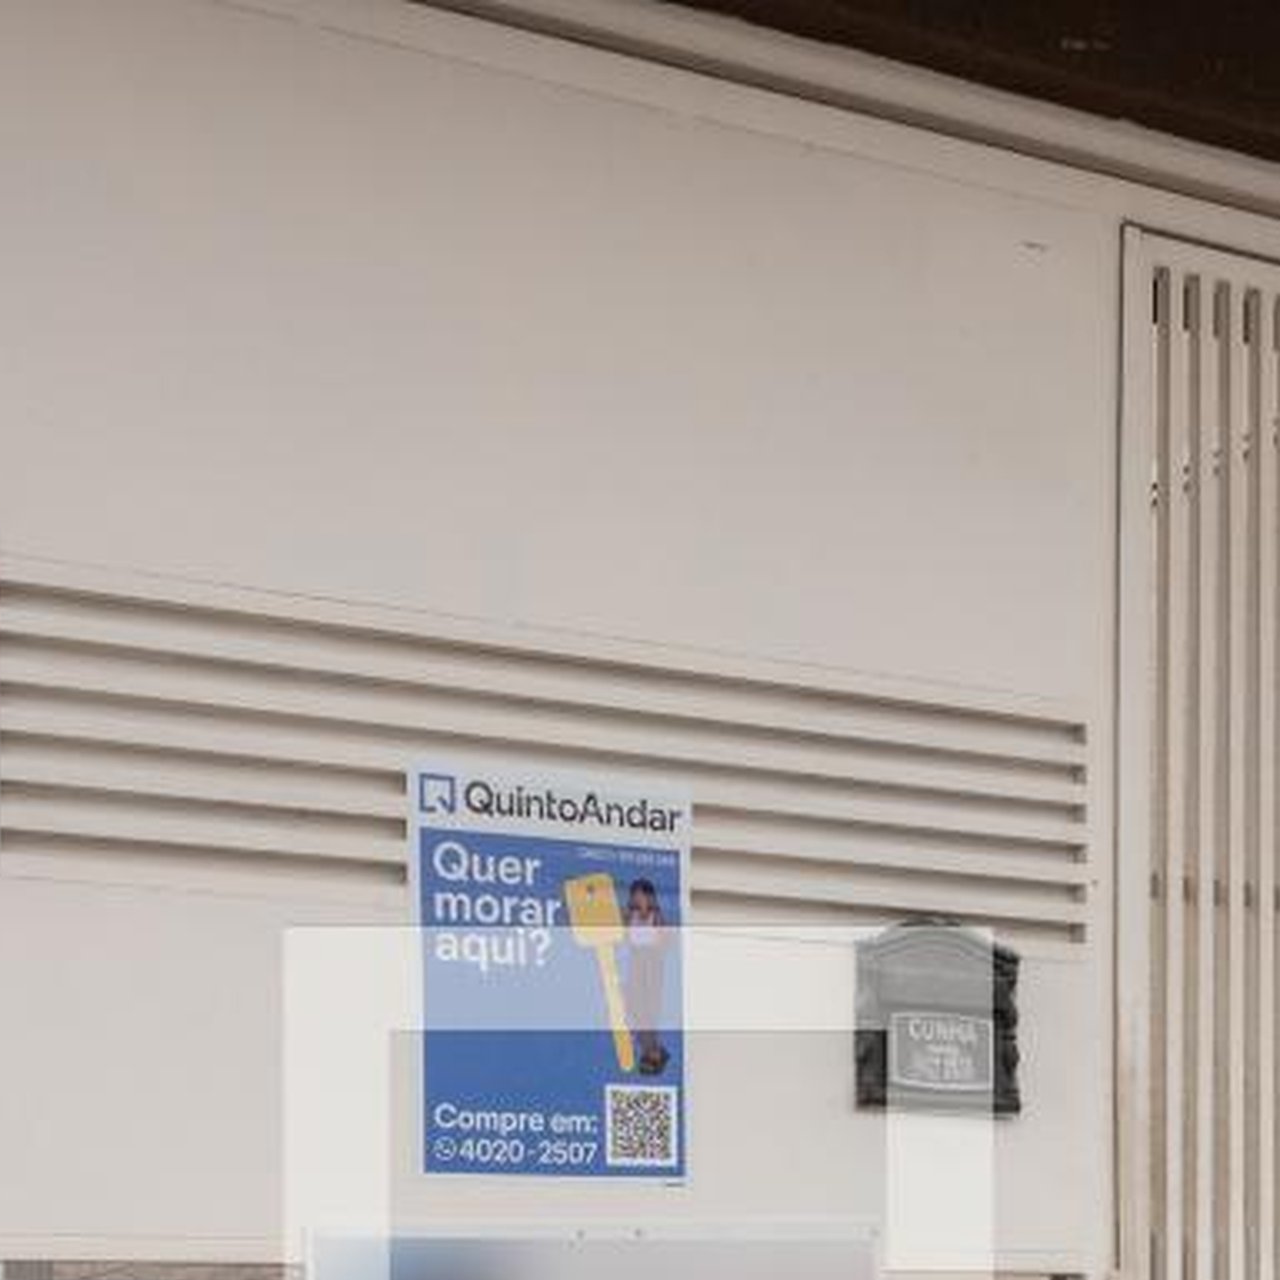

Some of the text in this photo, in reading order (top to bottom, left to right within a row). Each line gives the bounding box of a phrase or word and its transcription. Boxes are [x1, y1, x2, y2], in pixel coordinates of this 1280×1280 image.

[464, 781, 681, 832] QuintoAndar
[433, 841, 541, 885] Quer
[434, 892, 562, 925] morar
[437, 928, 550, 972] aqui?
[434, 1102, 598, 1136] Compre em:
